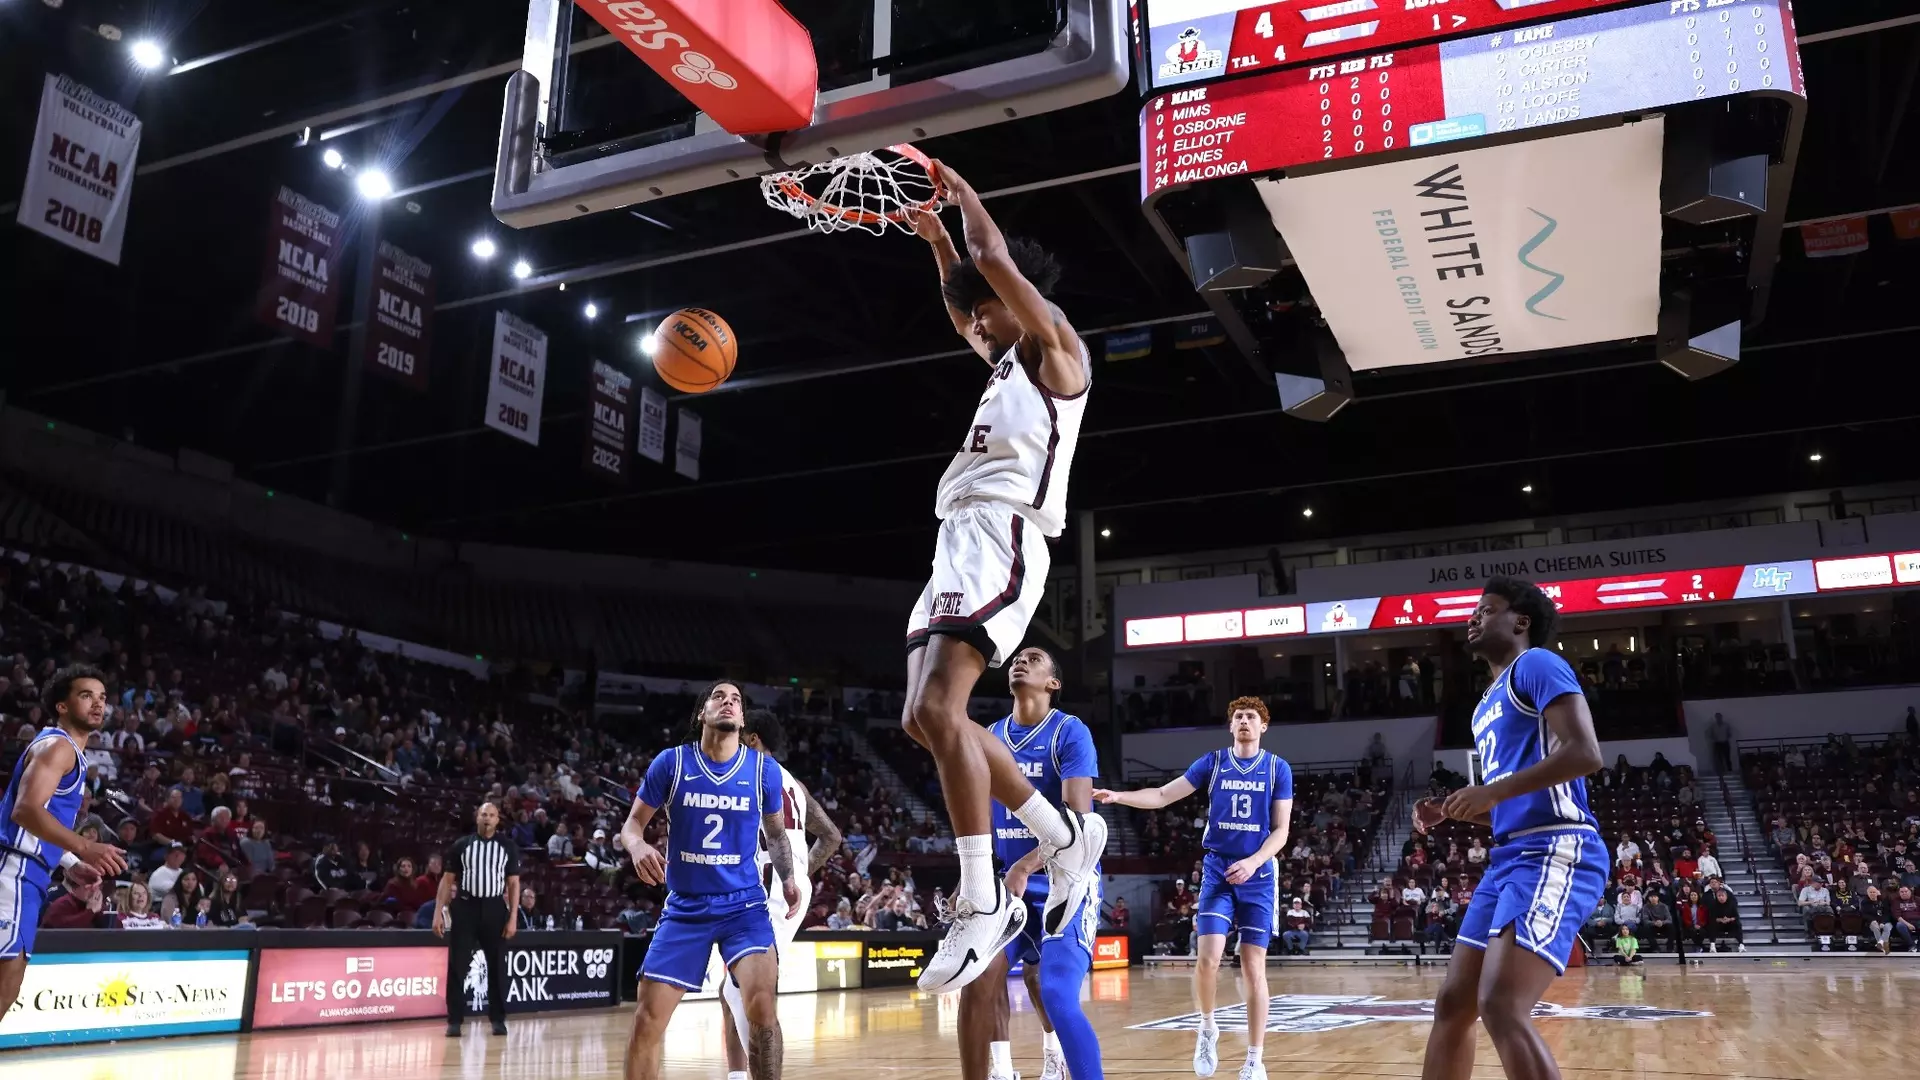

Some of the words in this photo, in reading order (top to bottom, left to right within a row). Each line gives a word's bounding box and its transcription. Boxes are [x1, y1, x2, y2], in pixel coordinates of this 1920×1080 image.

[1255, 12, 1275, 39] 4
[1432, 14, 1441, 30] 1
[1490, 35, 1503, 48] #
[1513, 25, 1554, 43] NAME
[1519, 34, 1599, 60] OGLESBY
[1685, 17, 1696, 29] 0
[1720, 10, 1730, 23] 0
[1752, 6, 1762, 18] 0
[1274, 45, 1286, 61] 4
[1520, 54, 1588, 77] CARTER
[1688, 33, 1698, 46] 0
[1724, 27, 1732, 39] 1
[1755, 23, 1765, 36] 0
[1171, 88, 1207, 105] NAME
[1309, 64, 1336, 80] PTS
[1340, 58, 1366, 74] REB
[1370, 54, 1394, 69] FLS
[1496, 83, 1513, 98] 10
[1520, 71, 1589, 94] ALSTON
[1690, 50, 1700, 63] 0
[1727, 44, 1734, 56] 1
[1757, 40, 1768, 53] 0
[1497, 100, 1515, 114] 13
[1522, 88, 1581, 110] LOOFE
[1693, 67, 1704, 80] 0
[1727, 61, 1738, 74] 0
[1760, 57, 1770, 70] 0
[1156, 114, 1164, 126] 0
[1172, 104, 1211, 121] MIMS
[1320, 82, 1329, 95] 0
[1350, 77, 1359, 89] 2
[1379, 72, 1388, 84] 0
[1156, 129, 1164, 141] 4
[1173, 112, 1246, 136] OSBORNE
[1320, 98, 1330, 110] 0
[1351, 93, 1360, 105] 0
[1380, 87, 1390, 99] 0
[1498, 116, 1516, 131] 22
[1523, 105, 1581, 126] LANDS
[1696, 84, 1706, 98] 2
[1729, 78, 1740, 91] 0
[1762, 74, 1773, 87] 0
[63, 98, 126, 139] VOLLEYBALL
[1156, 143, 1167, 157] 11
[1173, 130, 1234, 152] ELLIOTT
[1321, 114, 1331, 126] 0
[1352, 109, 1361, 121] 0
[1381, 103, 1391, 116] 0
[49, 131, 118, 188] NCAA
[1155, 158, 1167, 173] 21
[1174, 149, 1223, 168] JONES
[1323, 130, 1332, 142] 2
[1353, 125, 1363, 137] 0
[1383, 119, 1392, 132] 0
[1155, 174, 1168, 189] 24
[1174, 160, 1248, 183] MALONGA
[1324, 146, 1333, 158] 2
[1354, 140, 1364, 153] 0
[1384, 136, 1394, 148] 0
[48, 159, 116, 201] TOURNAMENT
[44, 197, 103, 245] 2018
[282, 215, 332, 247] BASKETBALL
[1413, 163, 1485, 281] WHITE
[278, 238, 329, 282] NCAA
[278, 263, 328, 294] TOURNAMENT
[1372, 208, 1411, 271] FEDERAL
[1395, 275, 1427, 315] CREDIT
[1412, 319, 1440, 351] UNION
[276, 296, 320, 333] 2018
[378, 289, 423, 328] NCAA
[673, 320, 708, 352] NCAA
[1446, 296, 1504, 356] SANDS
[377, 342, 415, 376] 2019
[499, 354, 536, 389] NCAA
[498, 402, 529, 432] 2019
[594, 400, 626, 433] NCAA
[592, 444, 620, 474] 2022
[1428, 568, 1458, 584] JAG
[1463, 567, 1476, 581] &
[1481, 560, 1529, 578] LINDA
[1534, 554, 1604, 574] CHEEMA
[1609, 548, 1667, 567] SUITES
[1692, 574, 1703, 589] 2
[1752, 567, 1792, 592] MT
[1402, 599, 1413, 613] 4
[1708, 591, 1715, 600] 4
[1478, 729, 1500, 782] 22
[682, 792, 751, 812] MIDDLE
[1220, 780, 1266, 792] MIDDLE
[1231, 793, 1252, 819] 13
[702, 813, 725, 850] 2
[1217, 821, 1261, 832] TENNESSEE
[680, 850, 741, 866] TENNESSEE
[505, 950, 579, 977] IONEER
[33, 989, 119, 1012] CRUCES
[123, 984, 229, 1007] SUN-NEWS
[271, 980, 326, 1003] LET'S
[331, 979, 362, 1000] GO
[366, 976, 438, 999] AGGIES!
[506, 976, 549, 1003] ANK
[319, 1004, 396, 1018] ALWAYSANAGGIE.COM
